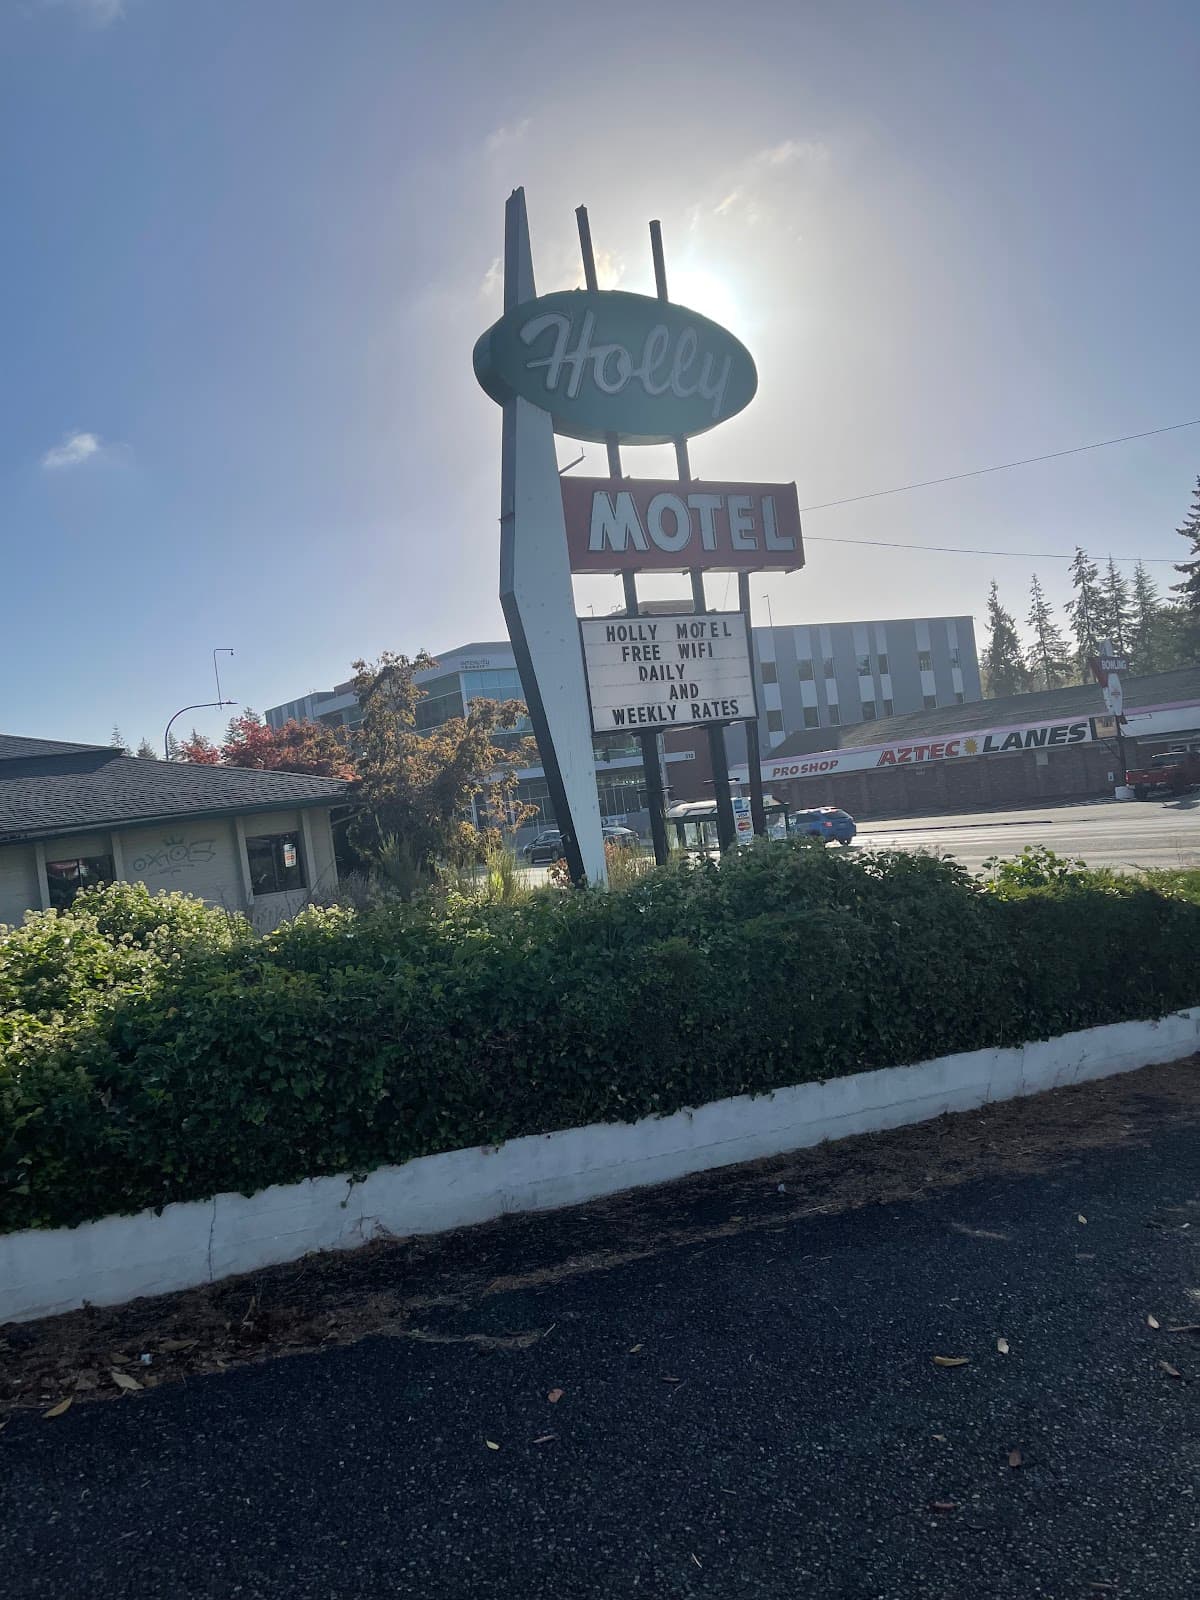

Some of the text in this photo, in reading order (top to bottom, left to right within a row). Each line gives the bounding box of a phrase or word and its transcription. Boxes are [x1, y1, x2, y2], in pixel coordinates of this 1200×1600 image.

[520, 309, 732, 418] Holly
[588, 491, 796, 552] MOTEL
[606, 621, 732, 642] HOLLY MOTEL
[621, 642, 713, 662] FREE WIFI
[638, 664, 685, 681] DAILY
[1101, 659, 1127, 670] BOWLING
[669, 683, 699, 700] AND
[612, 700, 739, 725] WEEKLY RATES
[876, 722, 1089, 767] AZTEC LANES
[772, 760, 839, 778] PRO SHOP
